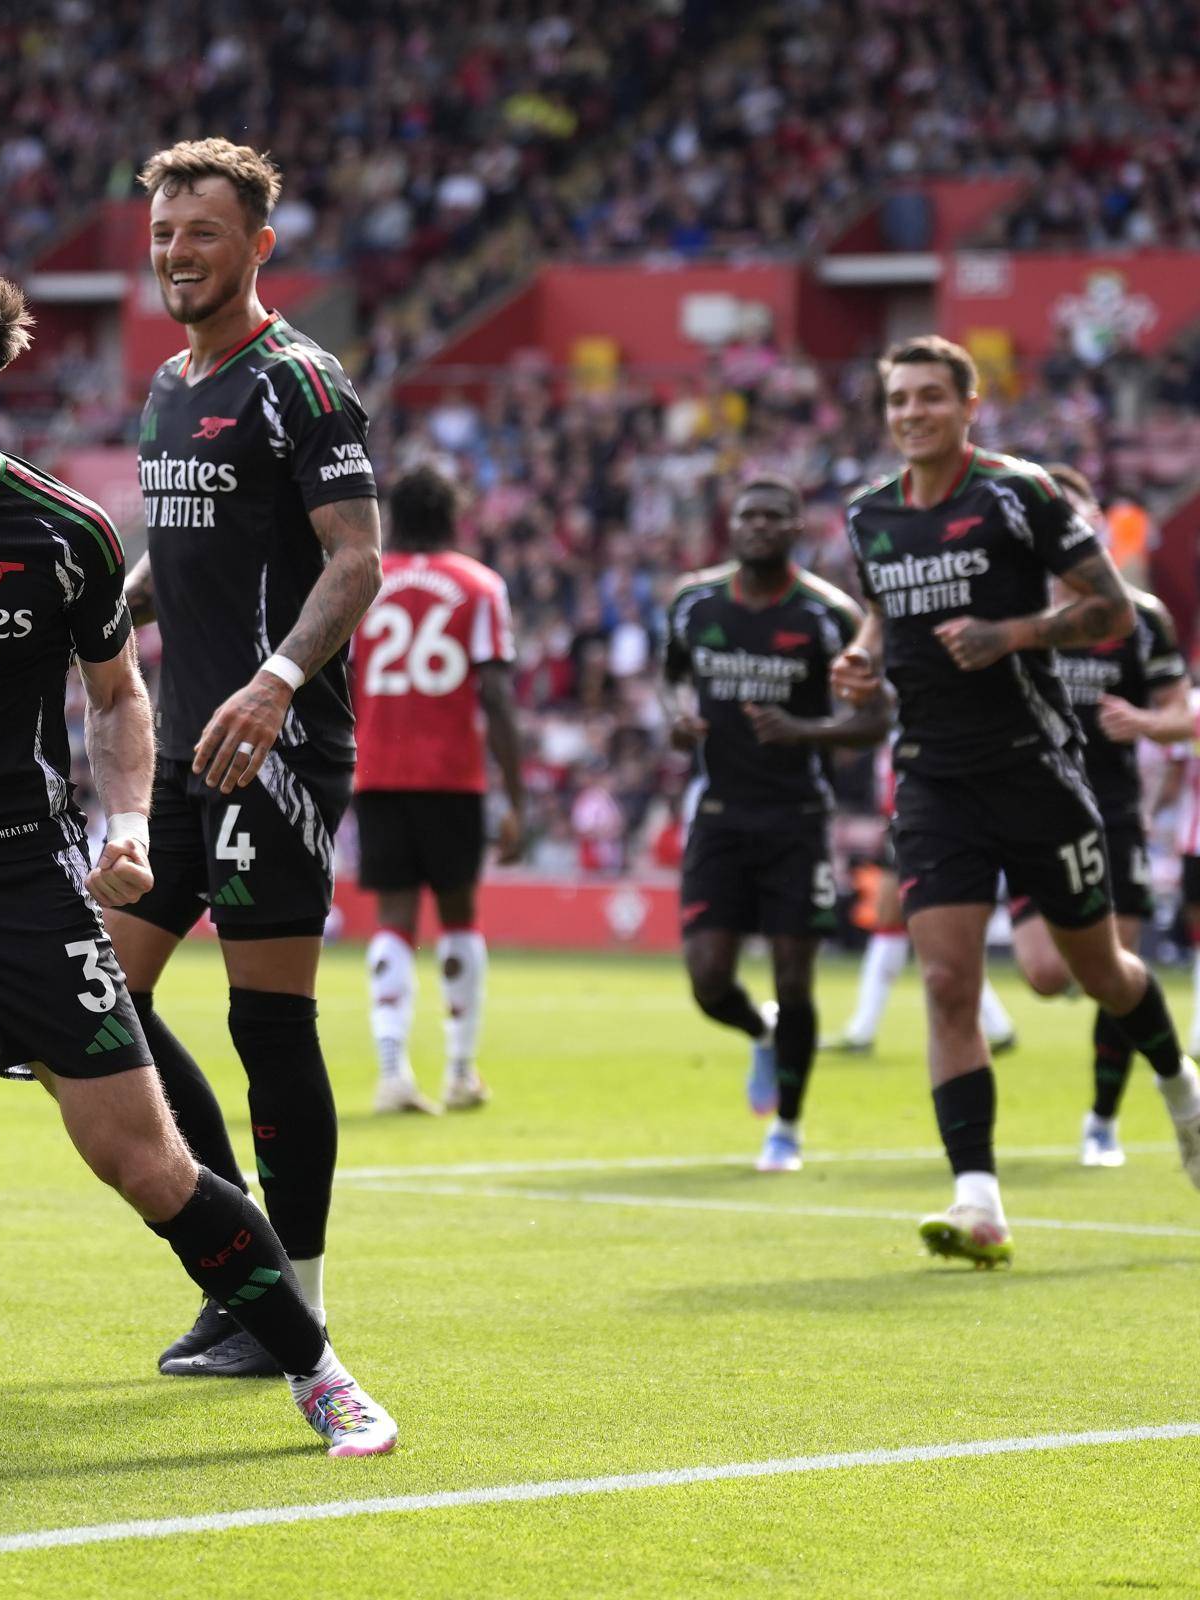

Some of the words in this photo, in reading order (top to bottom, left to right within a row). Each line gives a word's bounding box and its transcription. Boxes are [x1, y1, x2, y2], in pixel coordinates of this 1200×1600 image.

[137, 450, 238, 492] mirates
[319, 458, 373, 482] RWAN
[160, 496, 215, 528] BETTER
[866, 548, 990, 594] Emirates
[362, 601, 469, 698] 26
[0, 821, 39, 839] HEAT.RDY
[215, 804, 256, 871] 4
[1059, 831, 1104, 894] 15
[64, 939, 117, 1013] 3
[199, 1229, 251, 1268] AFC
